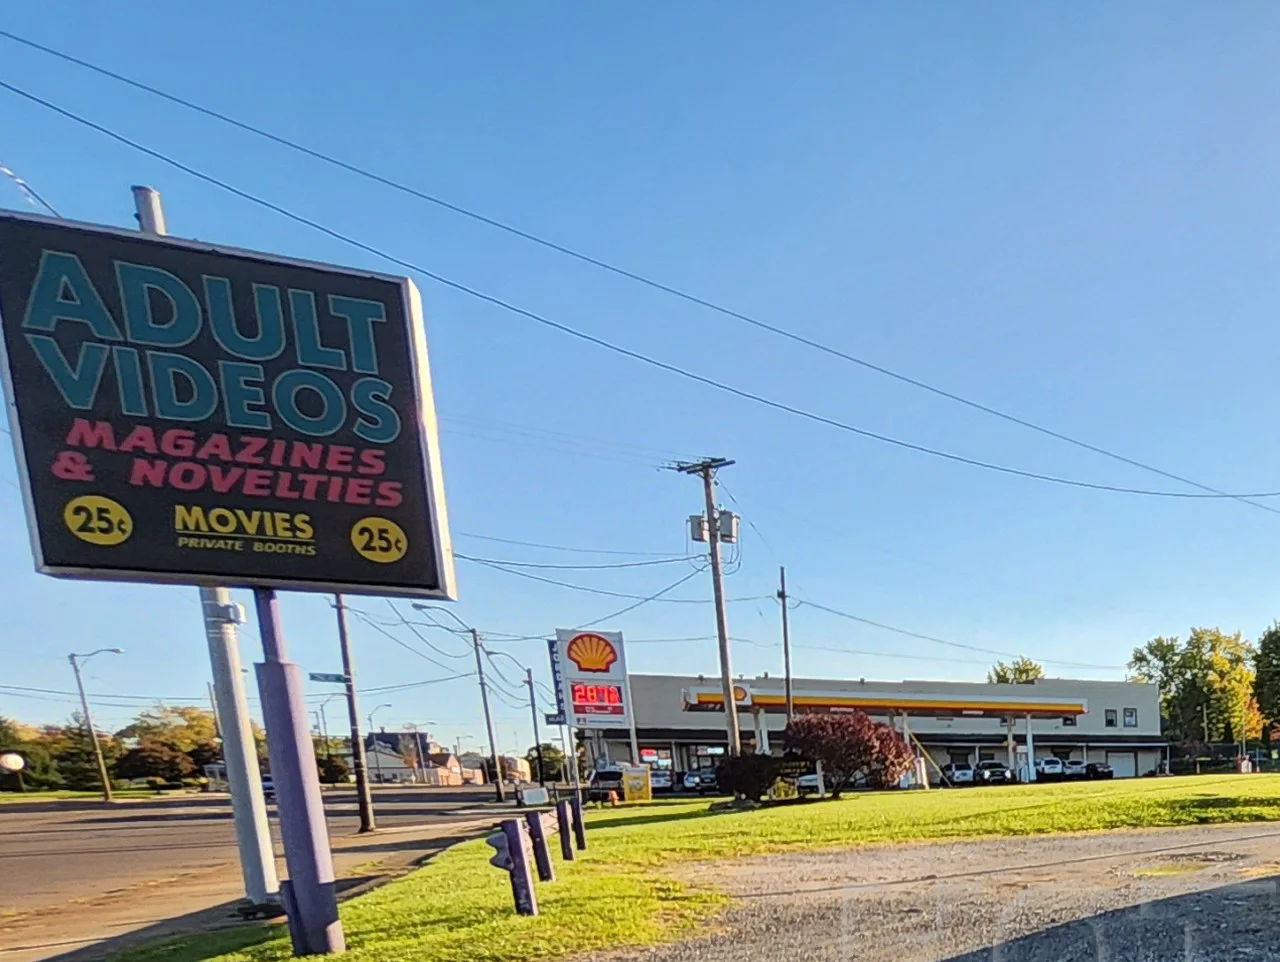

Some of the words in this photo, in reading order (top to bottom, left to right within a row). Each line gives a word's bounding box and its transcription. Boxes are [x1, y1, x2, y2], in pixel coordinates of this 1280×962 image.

[23, 249, 387, 374] ADULT
[24, 333, 401, 443] VIDEOS
[66, 417, 387, 475] MAGAZINES
[50, 450, 95, 481] &
[128, 458, 402, 508] NOVELTIES
[174, 504, 314, 539] MOVIES
[178, 535, 244, 552] PRIVATE
[253, 540, 316, 556] BOOTHS
